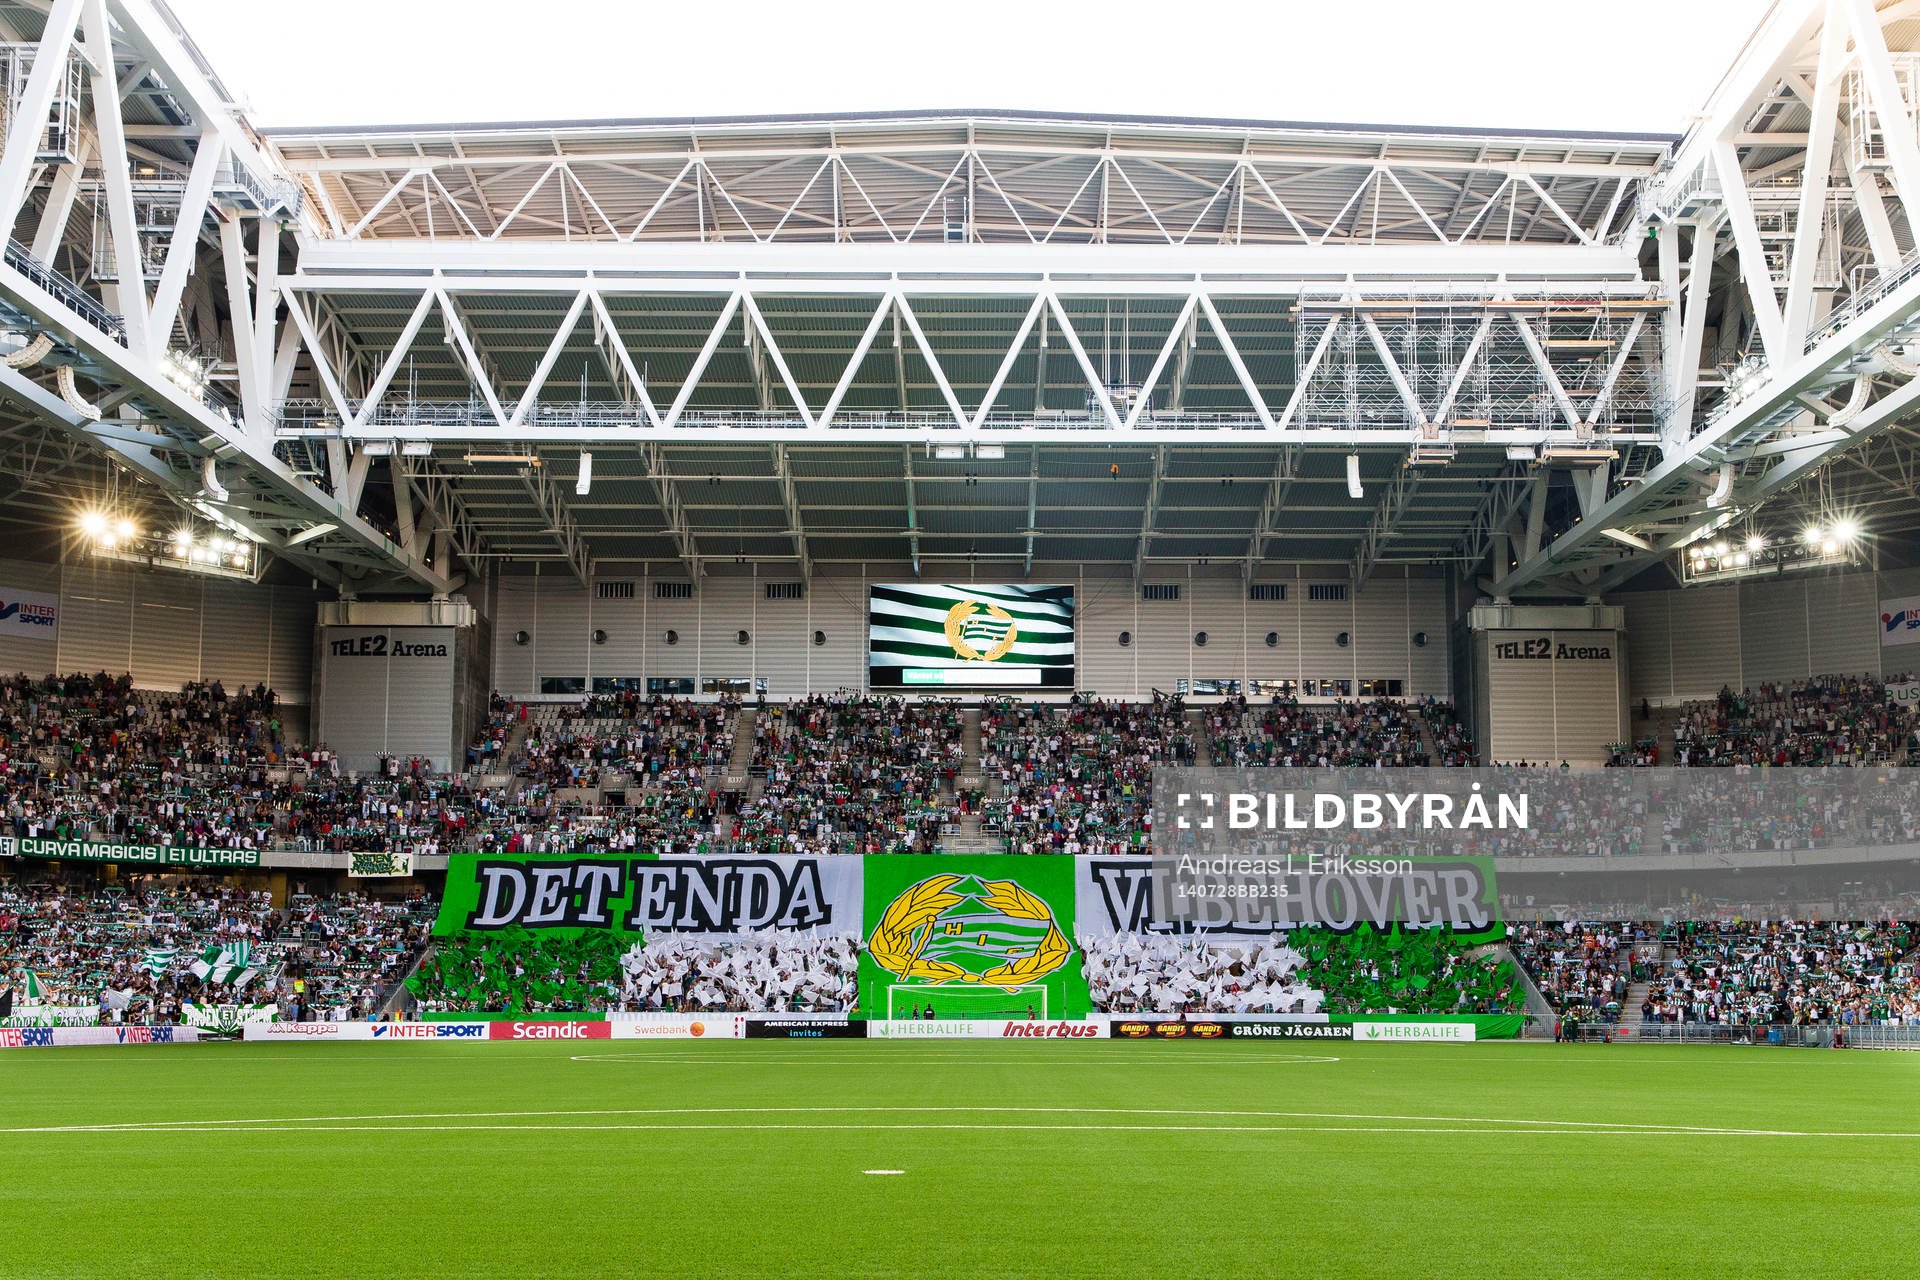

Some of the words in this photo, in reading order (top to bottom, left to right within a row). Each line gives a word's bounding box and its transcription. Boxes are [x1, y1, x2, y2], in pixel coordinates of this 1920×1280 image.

[20, 603, 55, 617] INTER
[19, 614, 55, 627] SPORT
[331, 635, 387, 657] TELE2
[391, 641, 447, 657] Arena
[1494, 638, 1552, 659] TELE2
[1555, 643, 1611, 660] Arena
[727, 776, 743, 784] B337
[22, 839, 81, 857] CURVA
[83, 843, 157, 860] MAGICIS
[170, 849, 186, 862] E1
[189, 849, 257, 864] ULTRAS
[470, 863, 624, 928] DET
[628, 862, 828, 930] ENDA
[1095, 864, 1179, 931] VI
[126, 1027, 174, 1043] INTERSPORT
[286, 1022, 339, 1034] Kappa
[389, 1025, 485, 1037] INTERSPORT
[512, 1021, 588, 1039] Scandic
[634, 1025, 688, 1034] Swedbank
[789, 1029, 823, 1037] invites
[898, 1023, 974, 1034] HERBALIFE
[1002, 1021, 1098, 1038] Interbus
[1233, 1024, 1282, 1036] GRÖNE
[1285, 1024, 1352, 1037] JÄGAREN
[1384, 1026, 1460, 1038] HERBALIFE
[0, 1027, 54, 1047] TERSPORT
